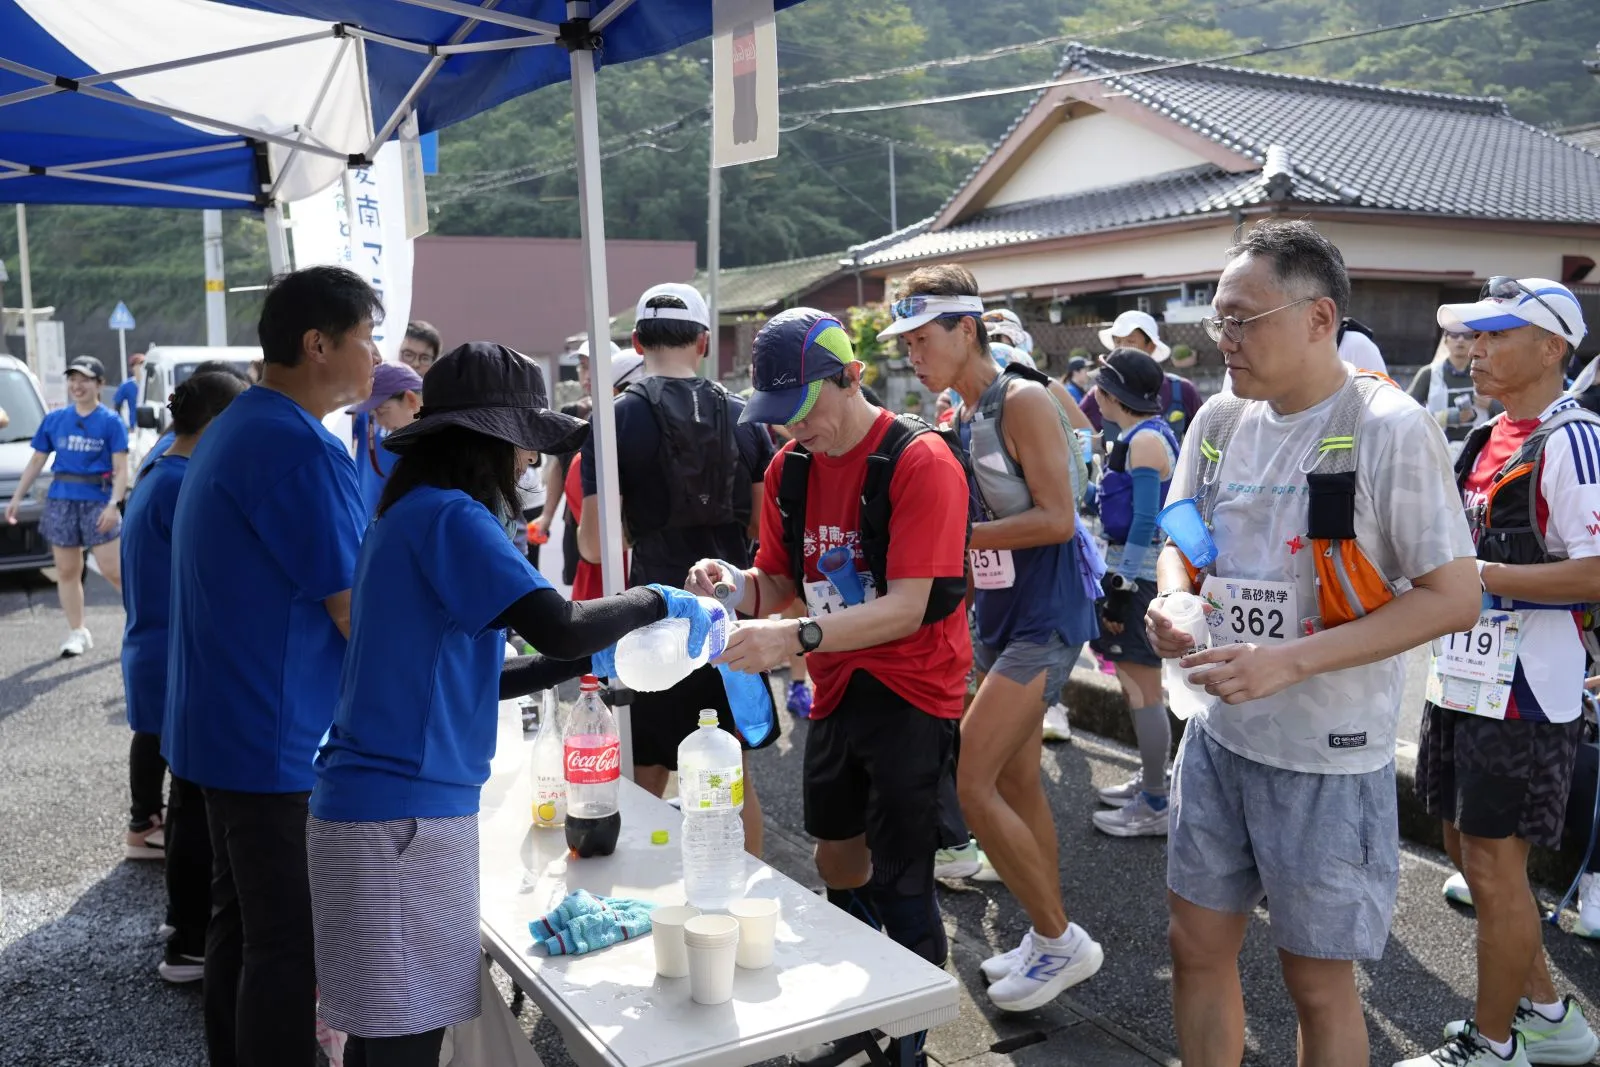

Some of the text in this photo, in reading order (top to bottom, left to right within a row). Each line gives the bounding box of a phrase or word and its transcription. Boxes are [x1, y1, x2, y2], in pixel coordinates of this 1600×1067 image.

[1241, 587, 1288, 603] 高砂熱学
[1230, 605, 1285, 639] 362
